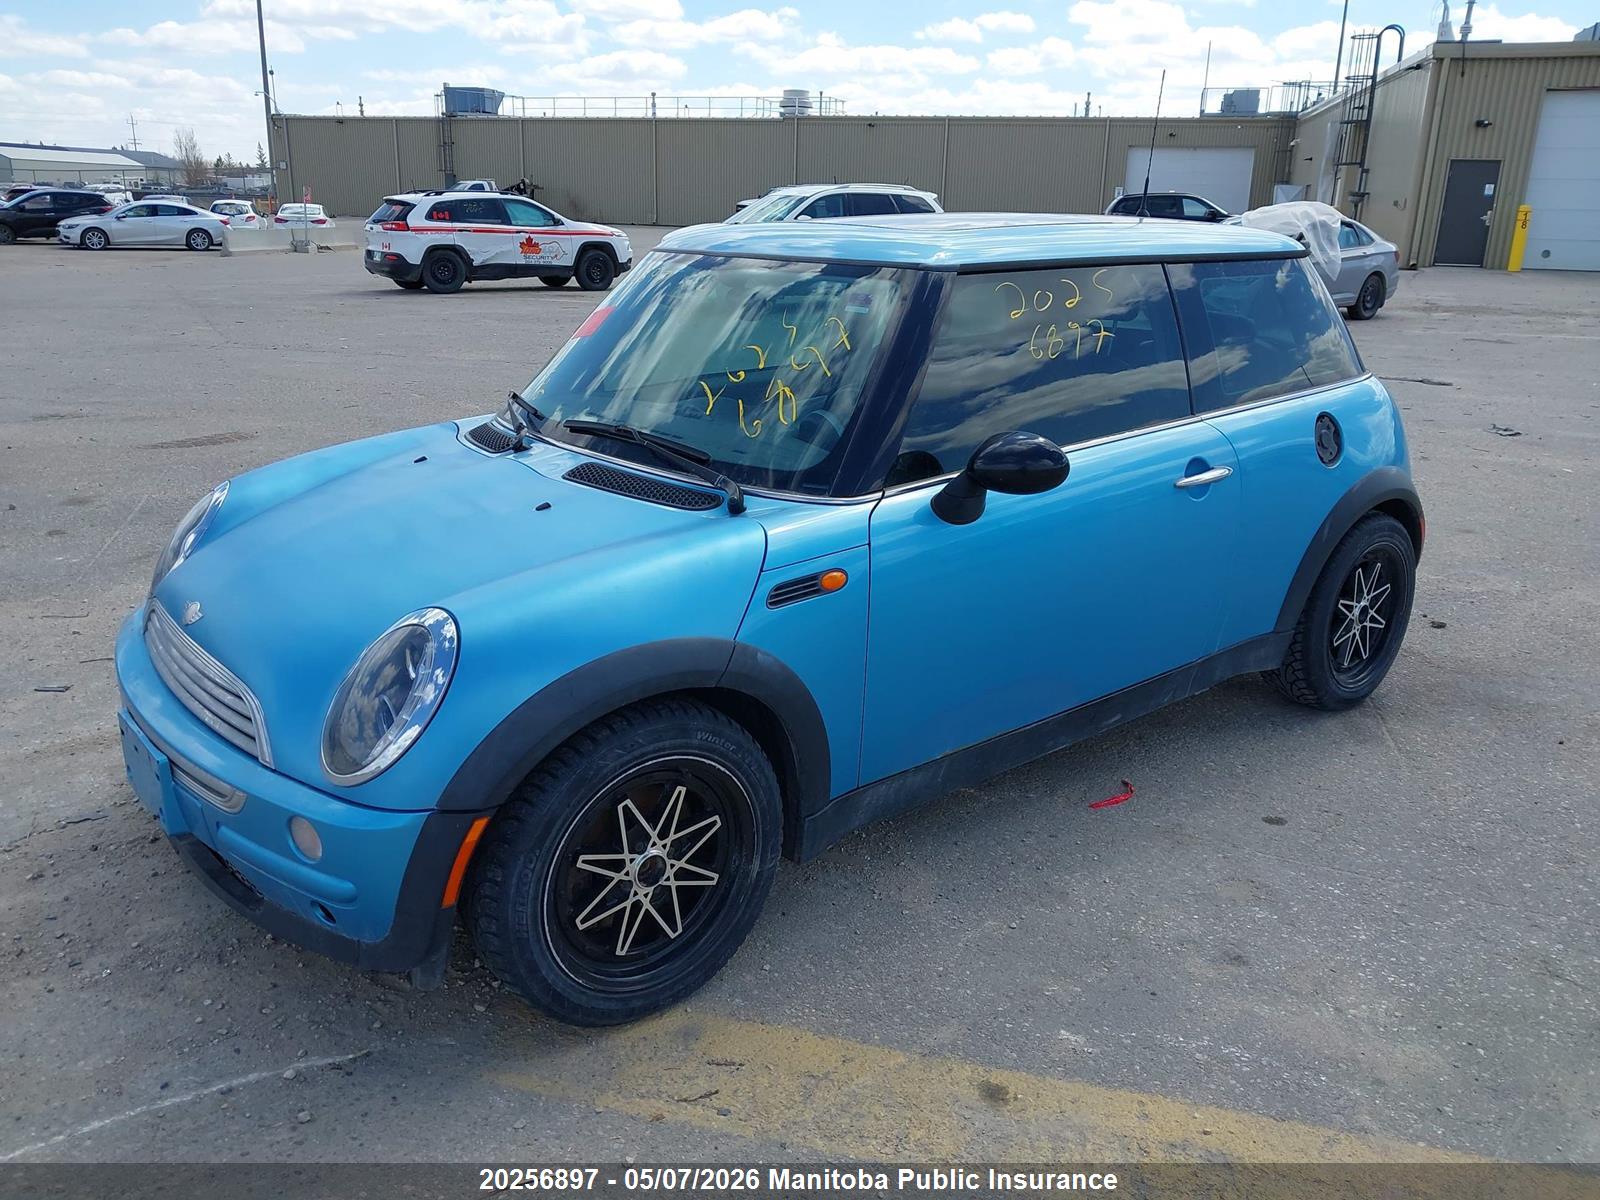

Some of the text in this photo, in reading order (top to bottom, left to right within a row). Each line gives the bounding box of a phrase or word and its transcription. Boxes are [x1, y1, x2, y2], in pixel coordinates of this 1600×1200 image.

[994, 268, 1114, 320] 2025
[699, 305, 798, 416] 2025
[1028, 318, 1116, 361] 6897
